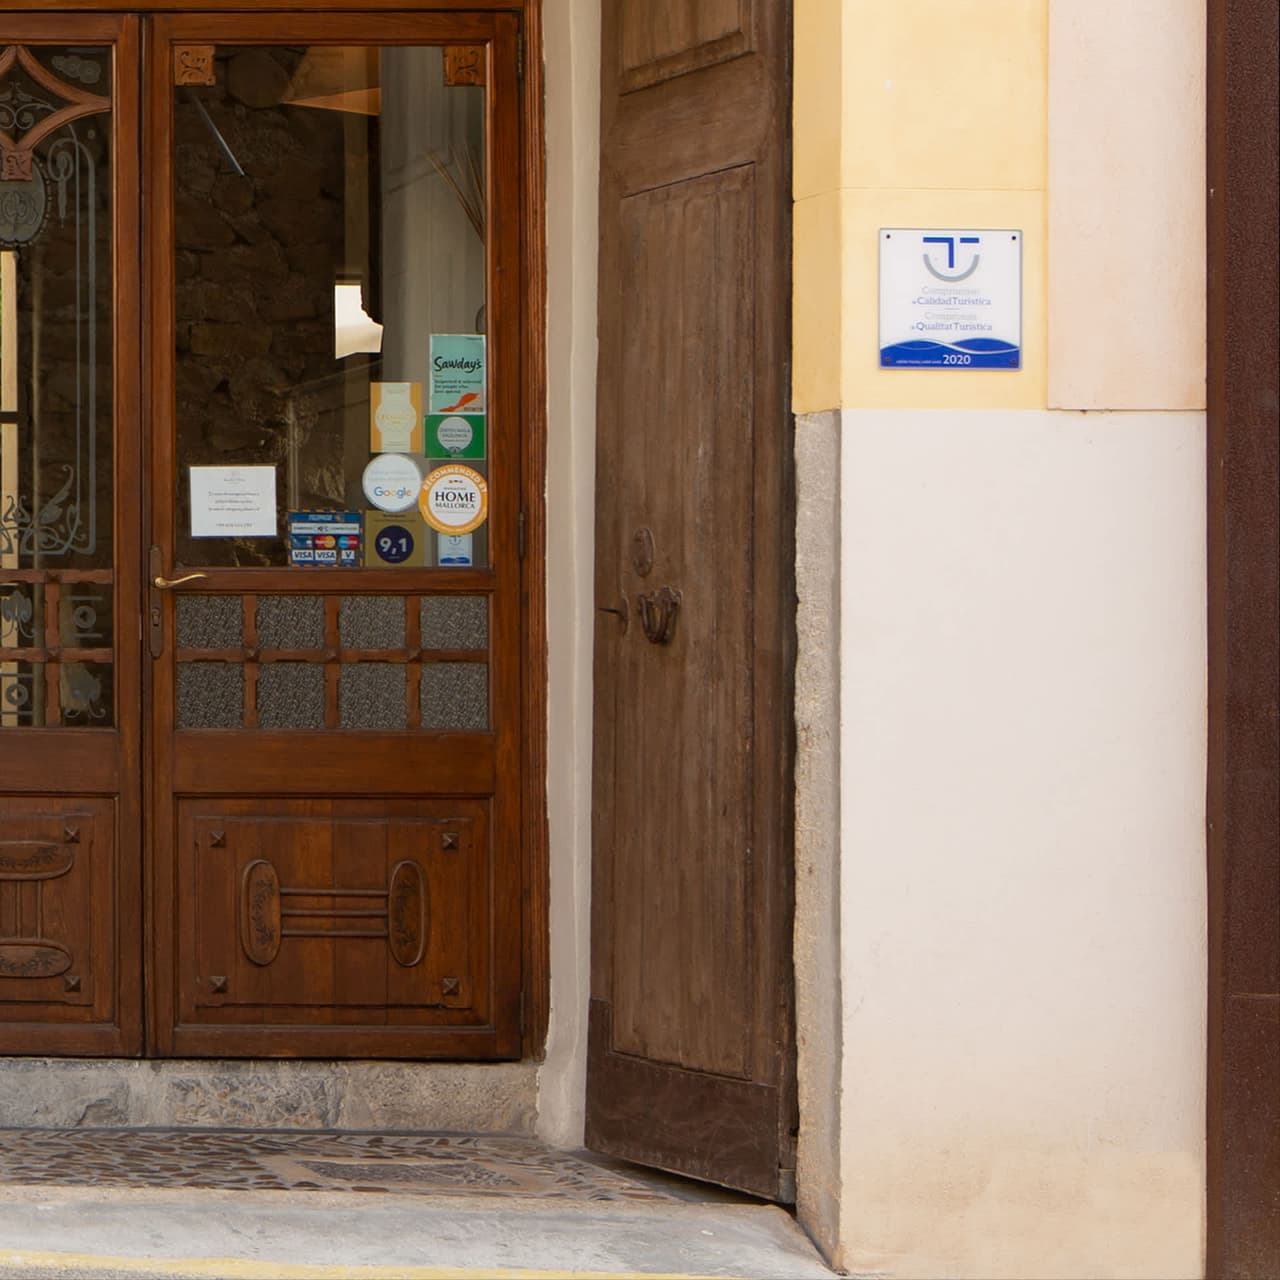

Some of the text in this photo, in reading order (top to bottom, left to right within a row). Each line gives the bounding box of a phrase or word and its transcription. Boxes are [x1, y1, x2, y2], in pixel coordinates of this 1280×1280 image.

[433, 356, 482, 373] Sawday's
[943, 354, 972, 365] 2020
[373, 486, 412, 499] Google
[435, 491, 476, 502] HOME
[380, 537, 408, 555] 9,1
[294, 551, 313, 559] VISA
[316, 551, 336, 559] VISA
